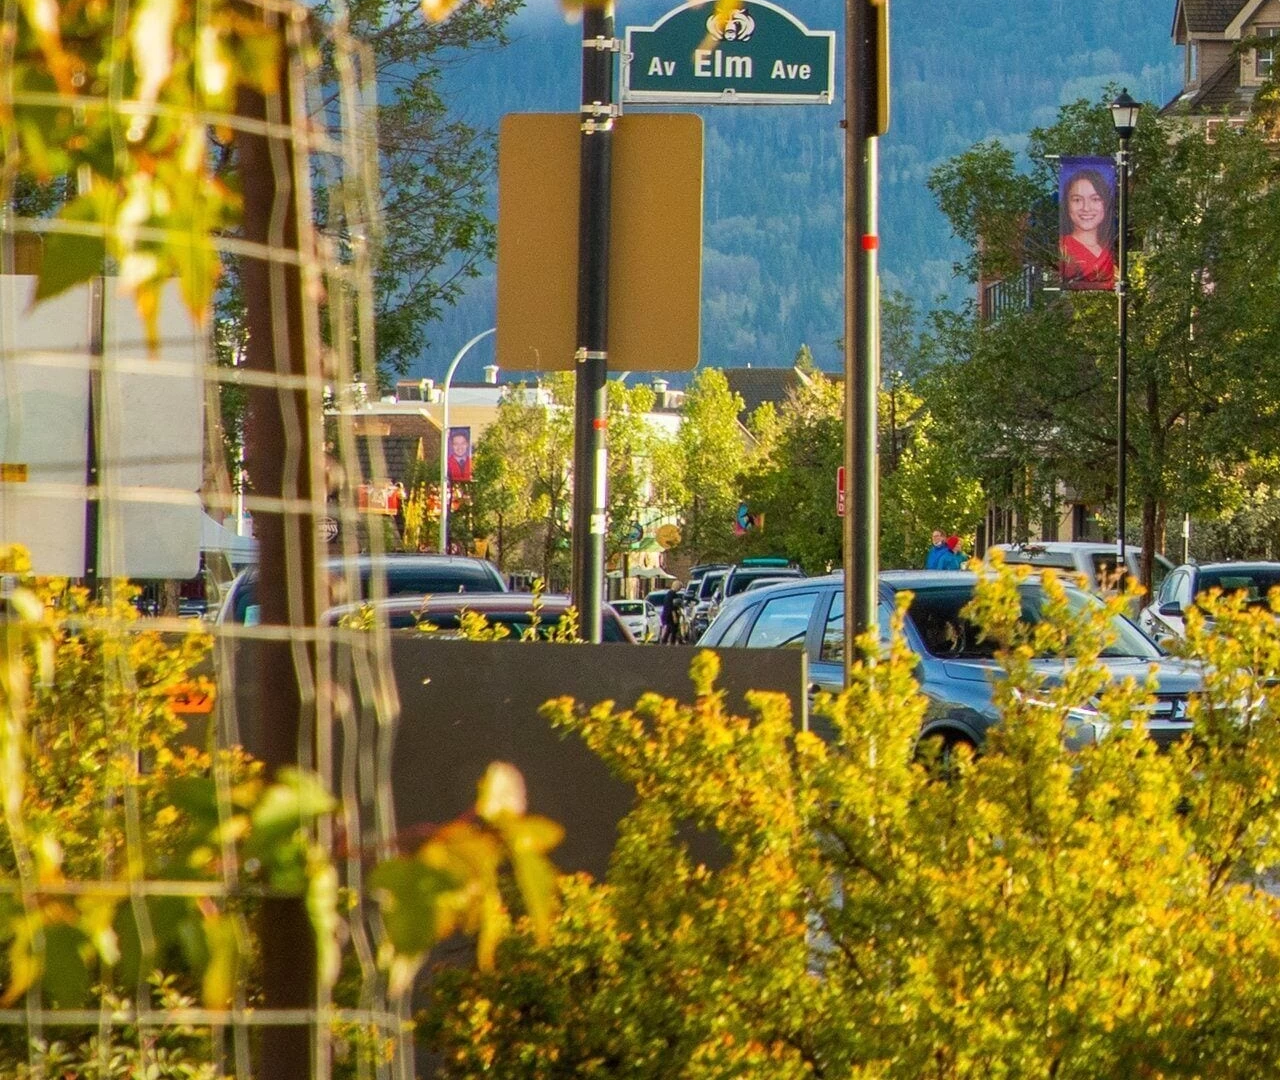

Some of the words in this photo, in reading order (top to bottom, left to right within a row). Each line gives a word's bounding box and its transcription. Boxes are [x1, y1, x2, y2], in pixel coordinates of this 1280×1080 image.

[648, 56, 676, 76] Av
[694, 48, 752, 79] Elm
[771, 59, 812, 80] Ave
